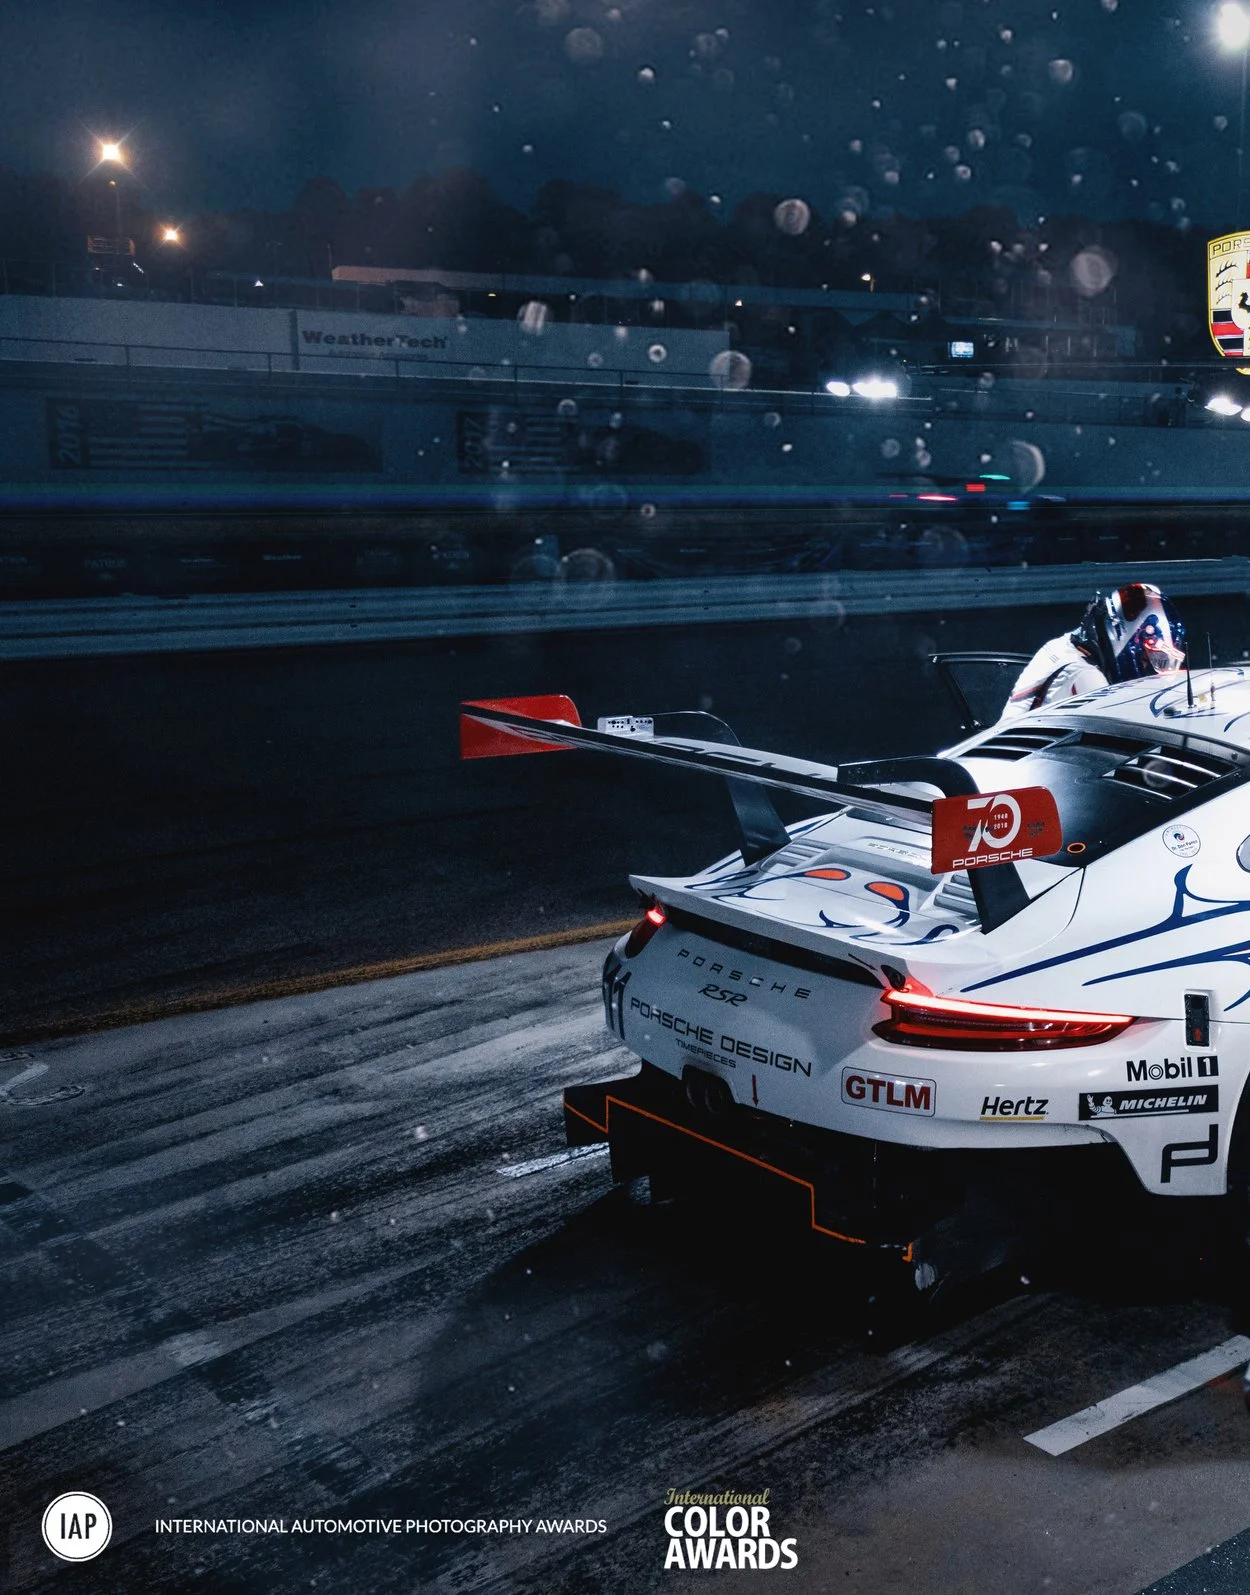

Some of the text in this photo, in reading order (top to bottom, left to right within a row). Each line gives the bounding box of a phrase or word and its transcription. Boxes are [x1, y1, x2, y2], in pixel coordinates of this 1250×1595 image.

[302, 330, 448, 349] WeatherTech
[967, 793, 1022, 852] 70
[952, 847, 1034, 869] PORSCHE
[677, 948, 812, 1000] PORSCHE
[698, 983, 748, 1007] RSR
[630, 996, 812, 1078] PORSCHE DESIGN
[675, 1037, 737, 1069] TIMEPIECES
[1126, 1056, 1193, 1082] Mobil
[845, 1075, 931, 1111] GTLM
[1118, 1094, 1208, 1111] MICHELIN
[981, 1096, 1048, 1117] Hertz
